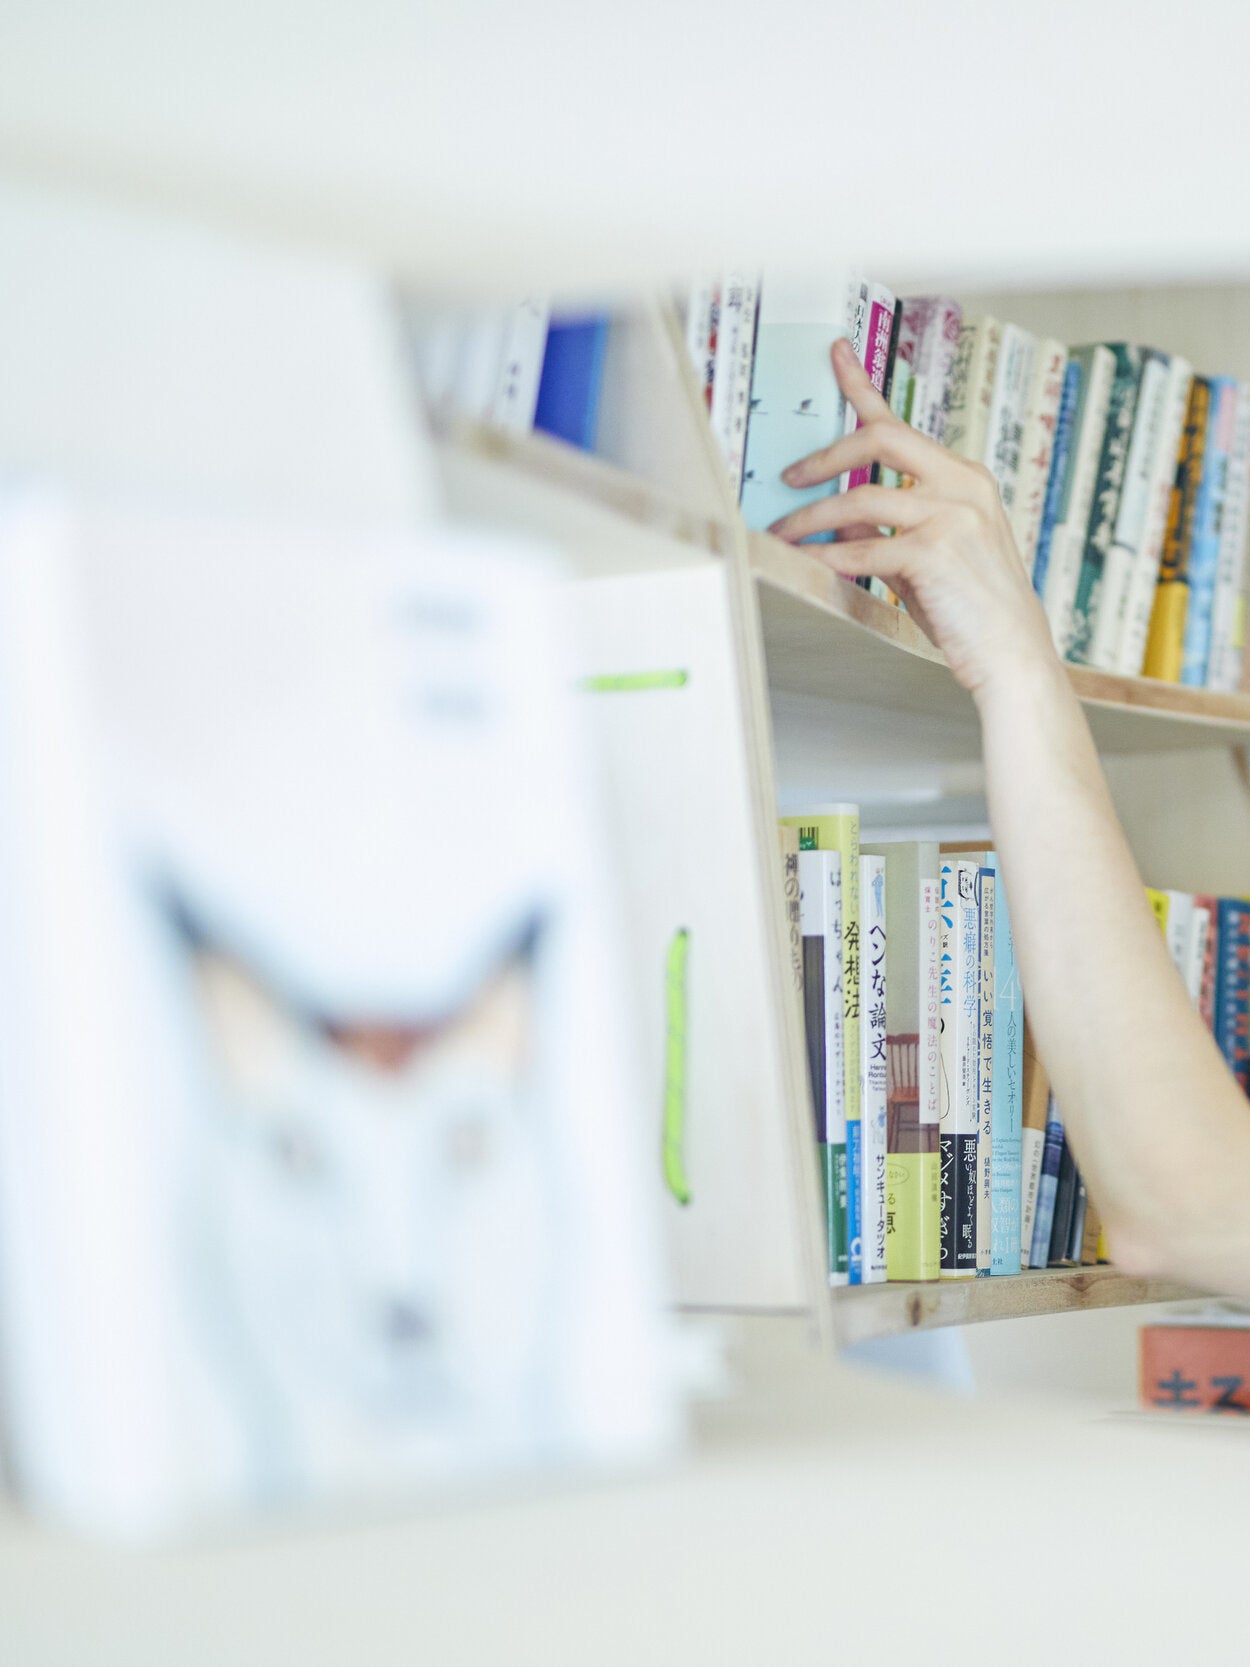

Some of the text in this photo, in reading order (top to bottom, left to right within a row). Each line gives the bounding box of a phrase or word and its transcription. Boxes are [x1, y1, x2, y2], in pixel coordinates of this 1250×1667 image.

[844, 920, 860, 1018] 発想法
[868, 925, 887, 1061] ヘンな論文
[927, 919, 938, 1111] のりこ先生の魔法のことば
[963, 907, 977, 1018] 悪癖の科学
[982, 970, 993, 1135] いい覚悟で生きる
[1007, 1013, 1018, 1132] 人の美しいセオリー
[875, 1155, 886, 1259] サンキュータツオ
[962, 1139, 977, 1248] 悪い奴ほどよく眠る
